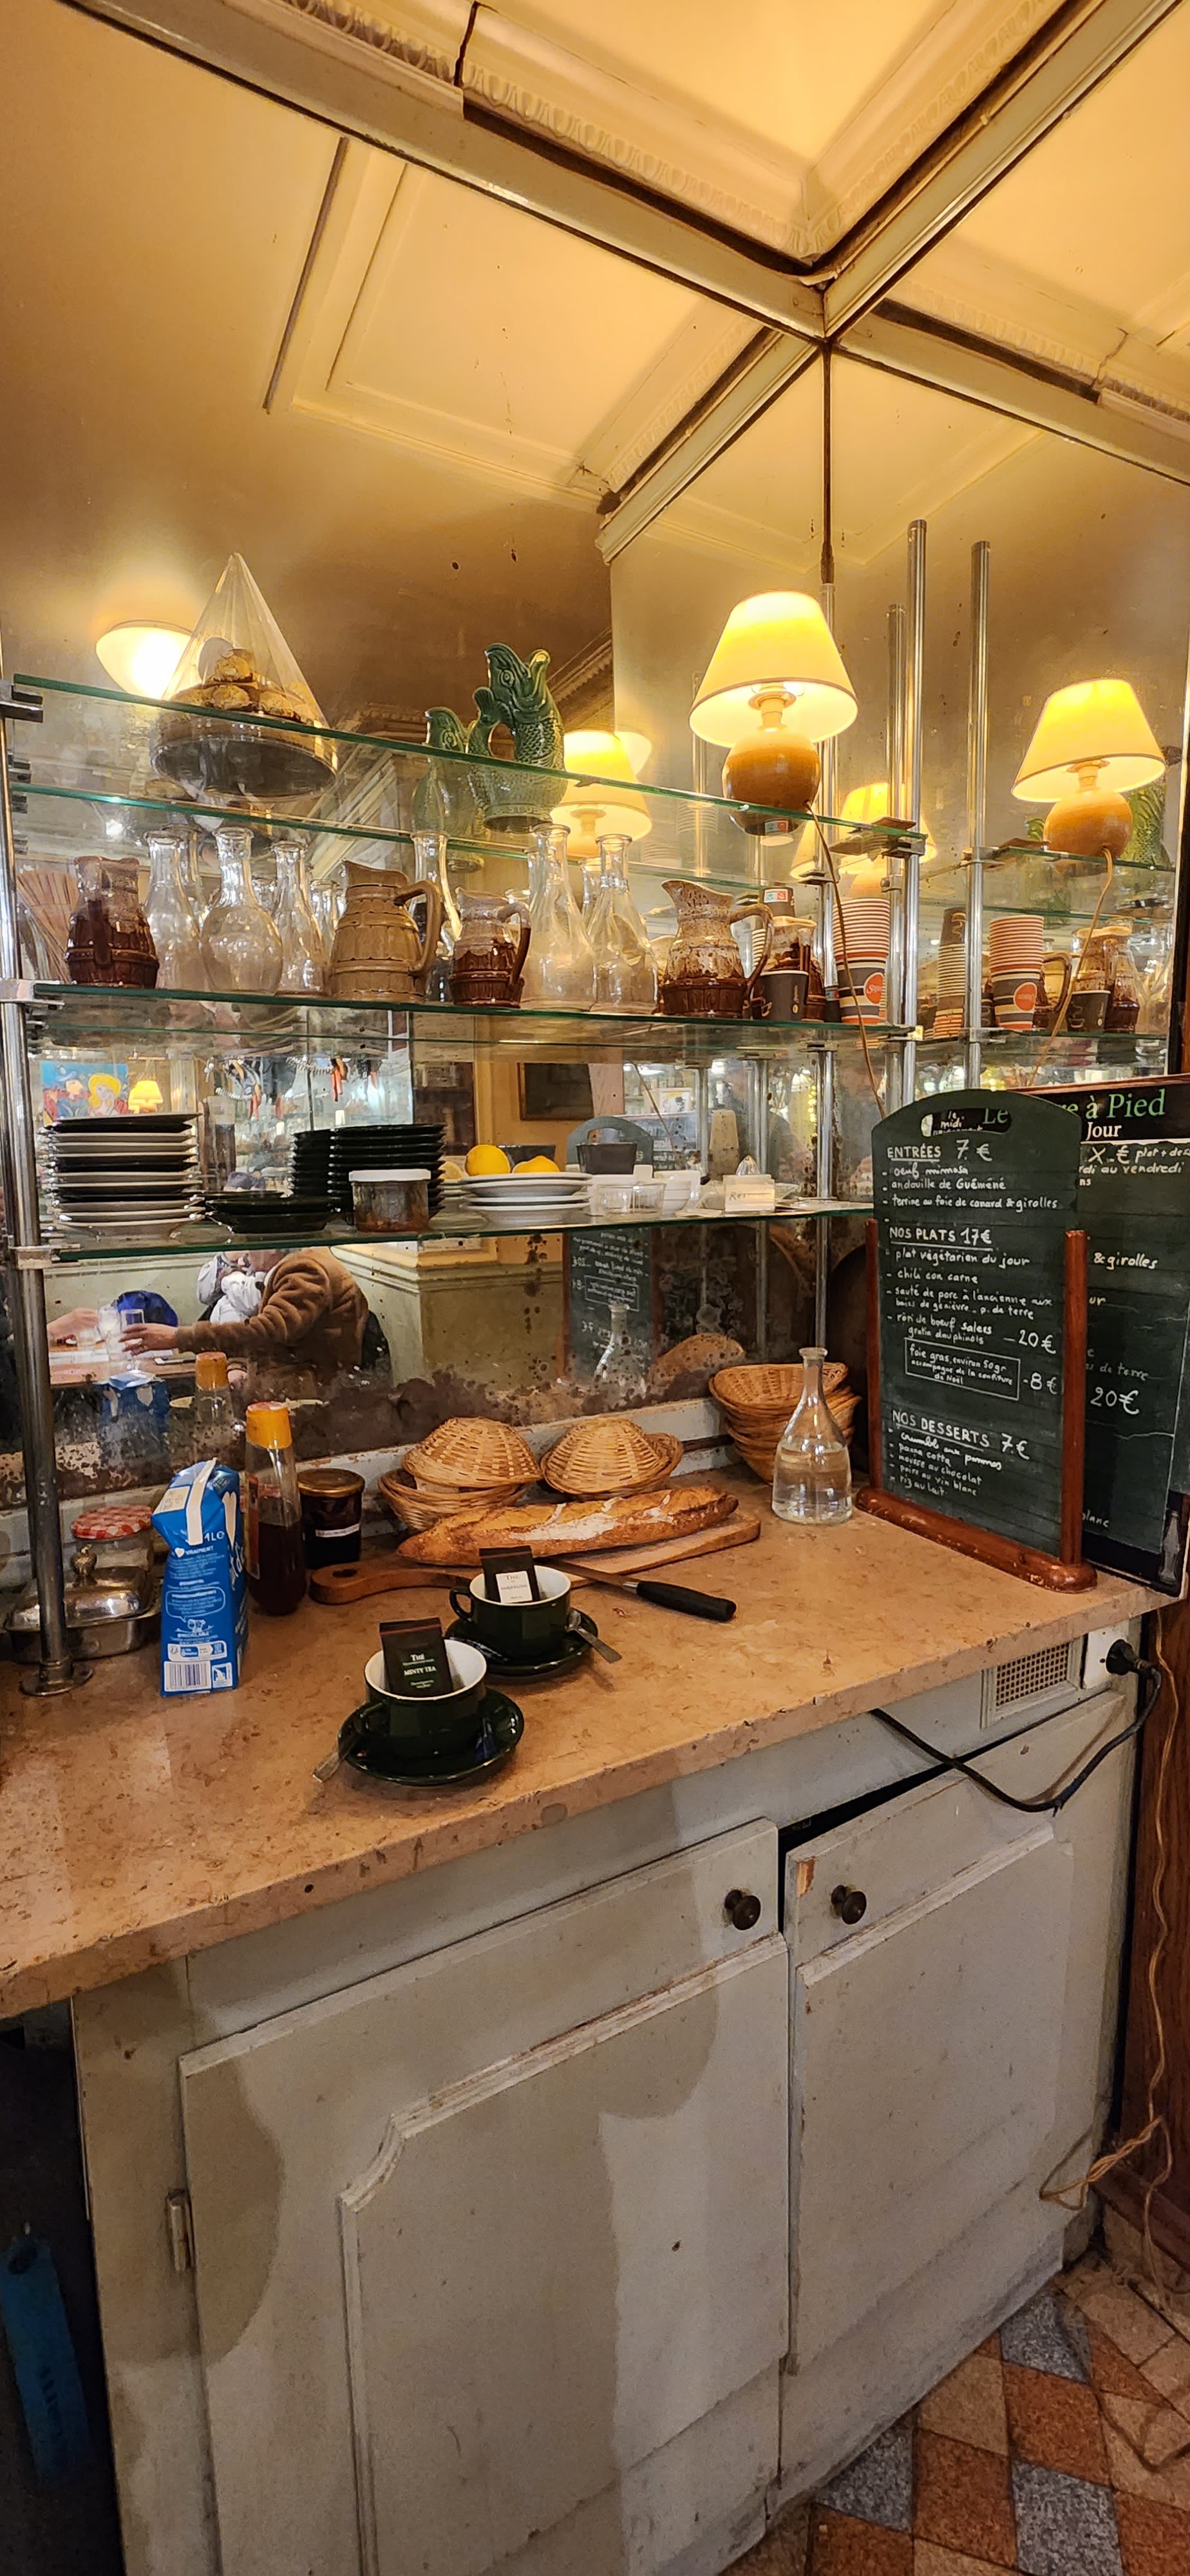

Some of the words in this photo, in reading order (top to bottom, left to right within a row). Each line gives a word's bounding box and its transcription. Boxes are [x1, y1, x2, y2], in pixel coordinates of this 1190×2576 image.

[1086, 1095, 1099, 1120] à
[1106, 1088, 1166, 1119] Pied
[941, 1116, 963, 1129] midi
[1085, 1121, 1122, 1141] Jour
[887, 1143, 941, 1158] ENTRÉES
[1135, 1148, 1159, 1163] plat
[925, 1164, 968, 1175] mimosa
[1100, 1165, 1118, 1174] au
[1122, 1160, 1185, 1174] vendredi
[938, 1178, 952, 1189] de
[956, 1177, 1006, 1190] Guéméné
[891, 1193, 921, 1207] terrine
[934, 1194, 952, 1207] foie
[955, 1196, 967, 1207] de
[969, 1196, 1003, 1209] canard
[889, 1226, 912, 1239] NOS
[916, 1228, 956, 1242] PLATS
[896, 1245, 916, 1262] plat
[920, 1249, 978, 1267] végétarien
[981, 1253, 997, 1264] du
[998, 1253, 1030, 1269] jour
[897, 1267, 921, 1280] chili
[925, 1272, 943, 1281] con
[947, 1273, 979, 1284] carne
[894, 1283, 920, 1297] sauté
[922, 1287, 934, 1298] de
[938, 1291, 959, 1304] porc
[920, 1300, 930, 1310] de
[992, 1304, 1005, 1314] de
[1008, 1305, 1035, 1320] terre
[908, 1327, 932, 1339] gratin
[909, 1343, 927, 1359] foie
[967, 1368, 976, 1378] la
[892, 1409, 916, 1427] NOS
[921, 1417, 990, 1448] DESSERTS
[964, 1454, 1003, 1471] pommes
[900, 1464, 920, 1477] poire
[934, 1476, 950, 1487] vin
[953, 1480, 978, 1497] blanc
[928, 1463, 940, 1472] au
[941, 1466, 983, 1486] chocolat
